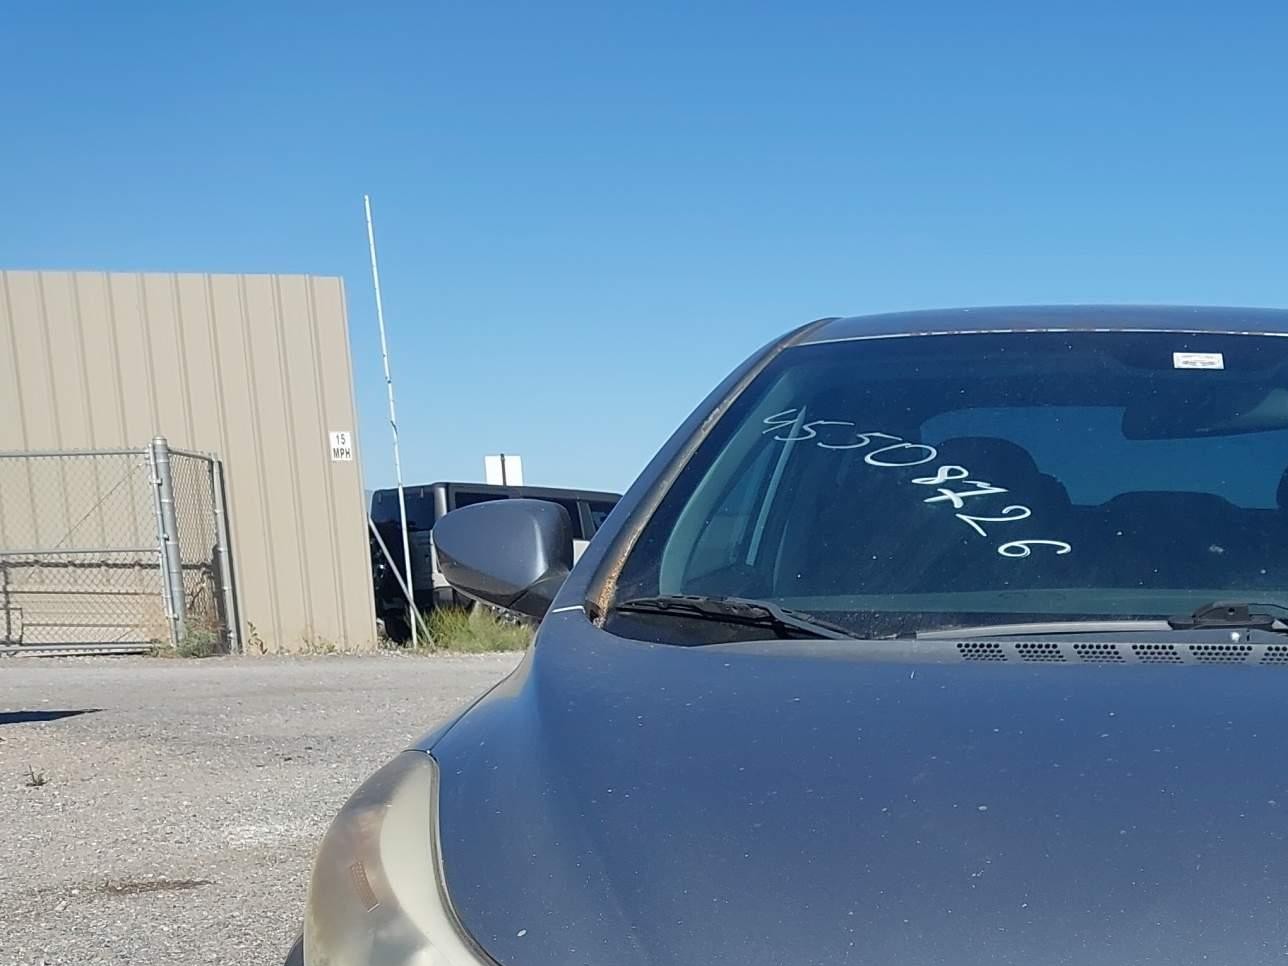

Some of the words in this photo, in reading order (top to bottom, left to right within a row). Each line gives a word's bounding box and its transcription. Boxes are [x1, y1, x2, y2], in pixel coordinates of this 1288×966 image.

[336, 433, 346, 445] 15
[333, 447, 351, 458] MPH
[762, 408, 1071, 557] 45508726
